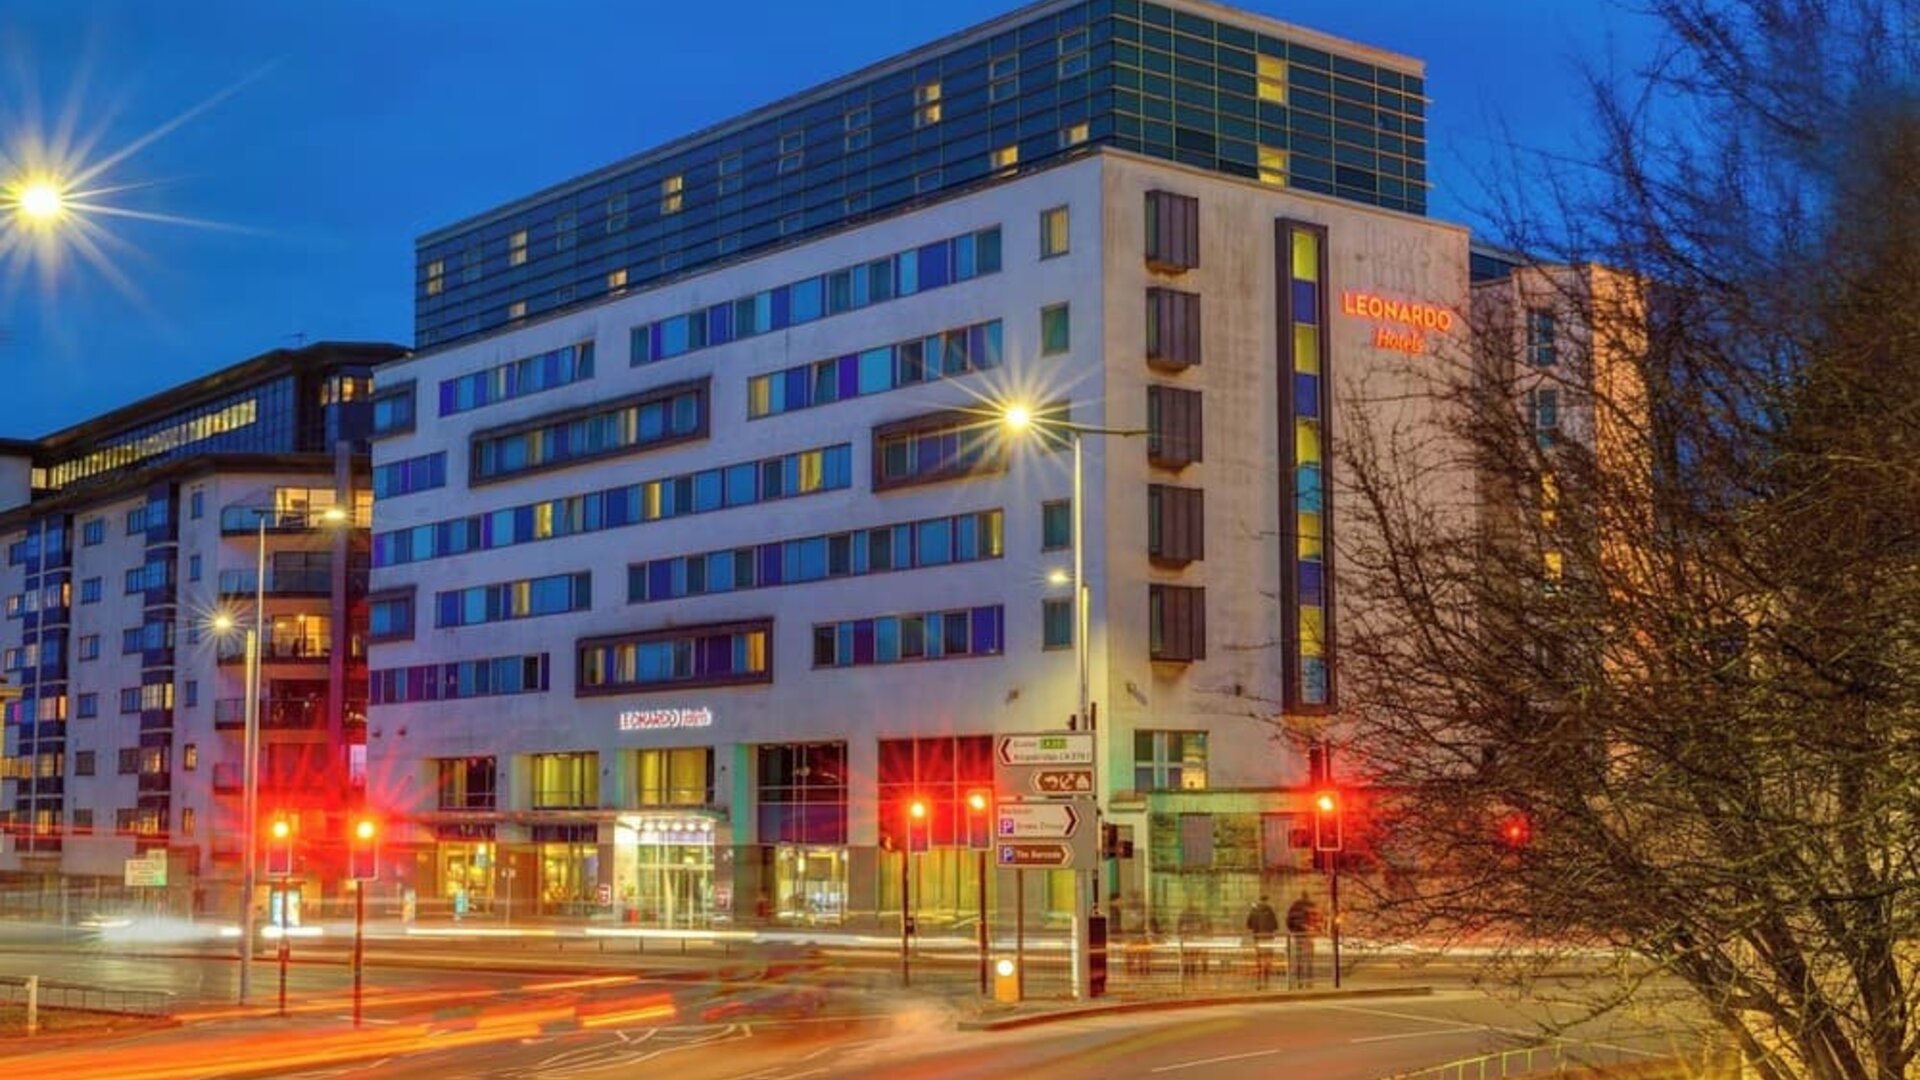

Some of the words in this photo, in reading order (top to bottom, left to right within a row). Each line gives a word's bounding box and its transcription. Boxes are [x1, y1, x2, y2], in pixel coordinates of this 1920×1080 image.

[1343, 291, 1452, 331] LEONARDO
[1376, 327, 1425, 354] Hotels
[619, 709, 680, 731] LEONARDO
